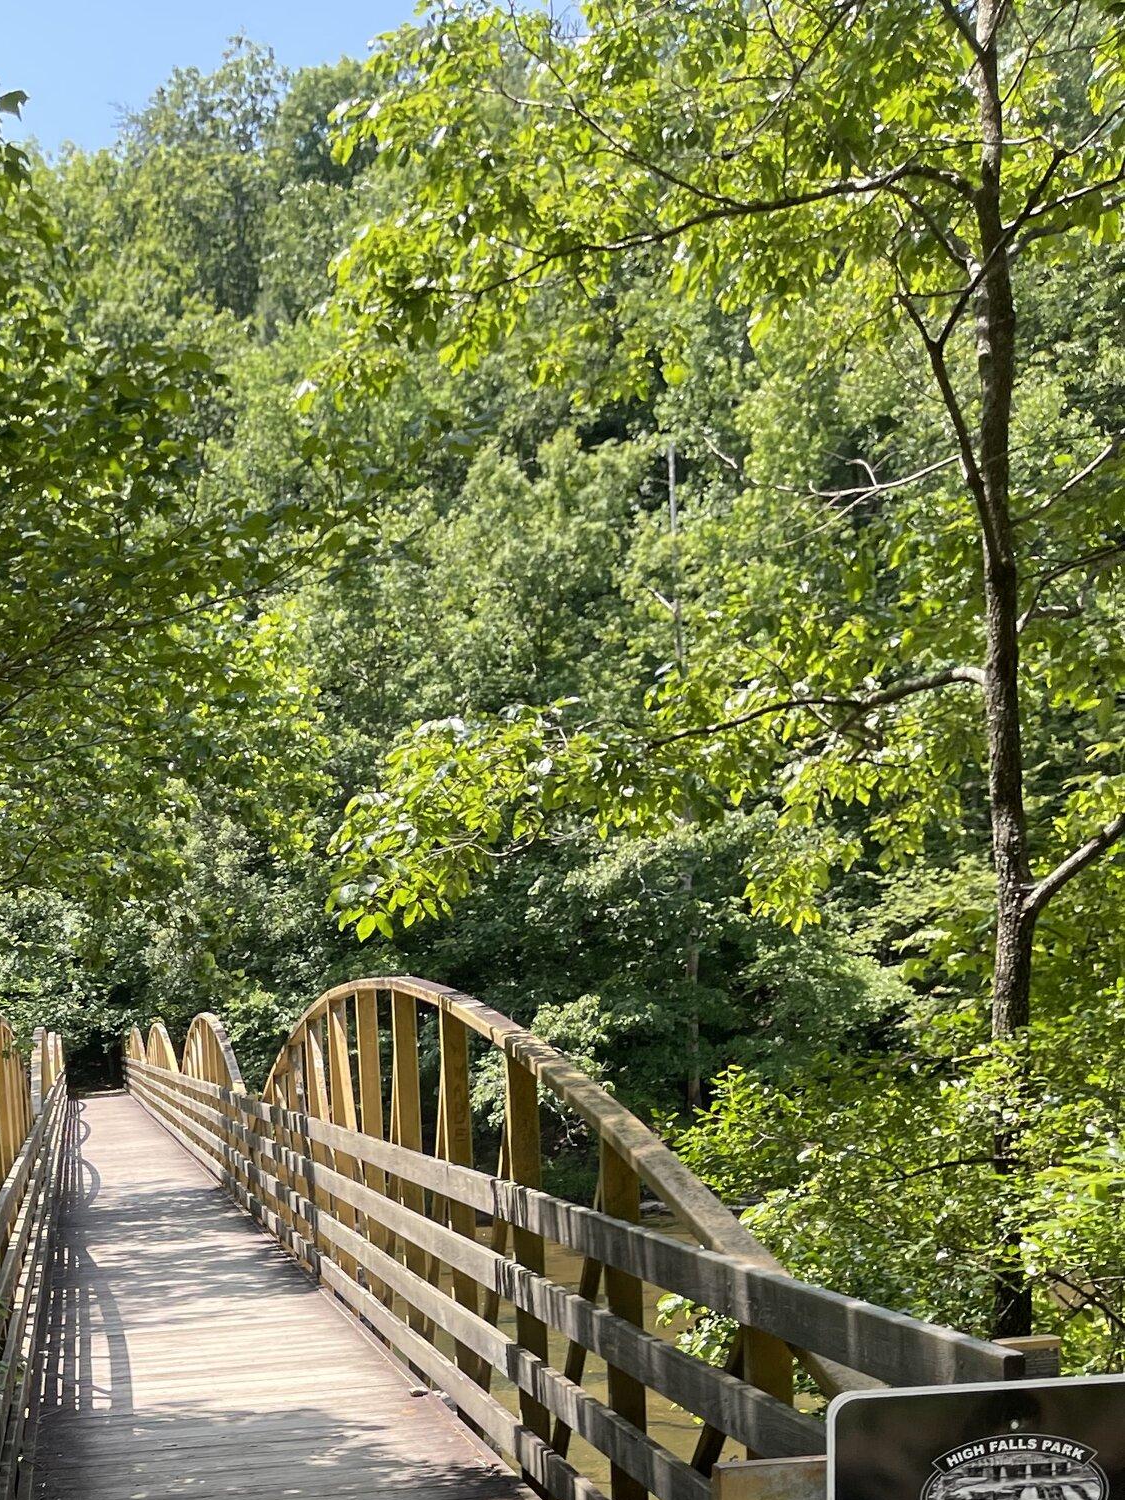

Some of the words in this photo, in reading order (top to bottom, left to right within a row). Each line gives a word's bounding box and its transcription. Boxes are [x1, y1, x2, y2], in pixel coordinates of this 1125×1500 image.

[945, 1444, 985, 1467] HIGH
[989, 1438, 1037, 1452] FALLS
[1041, 1439, 1086, 1460] PARK
